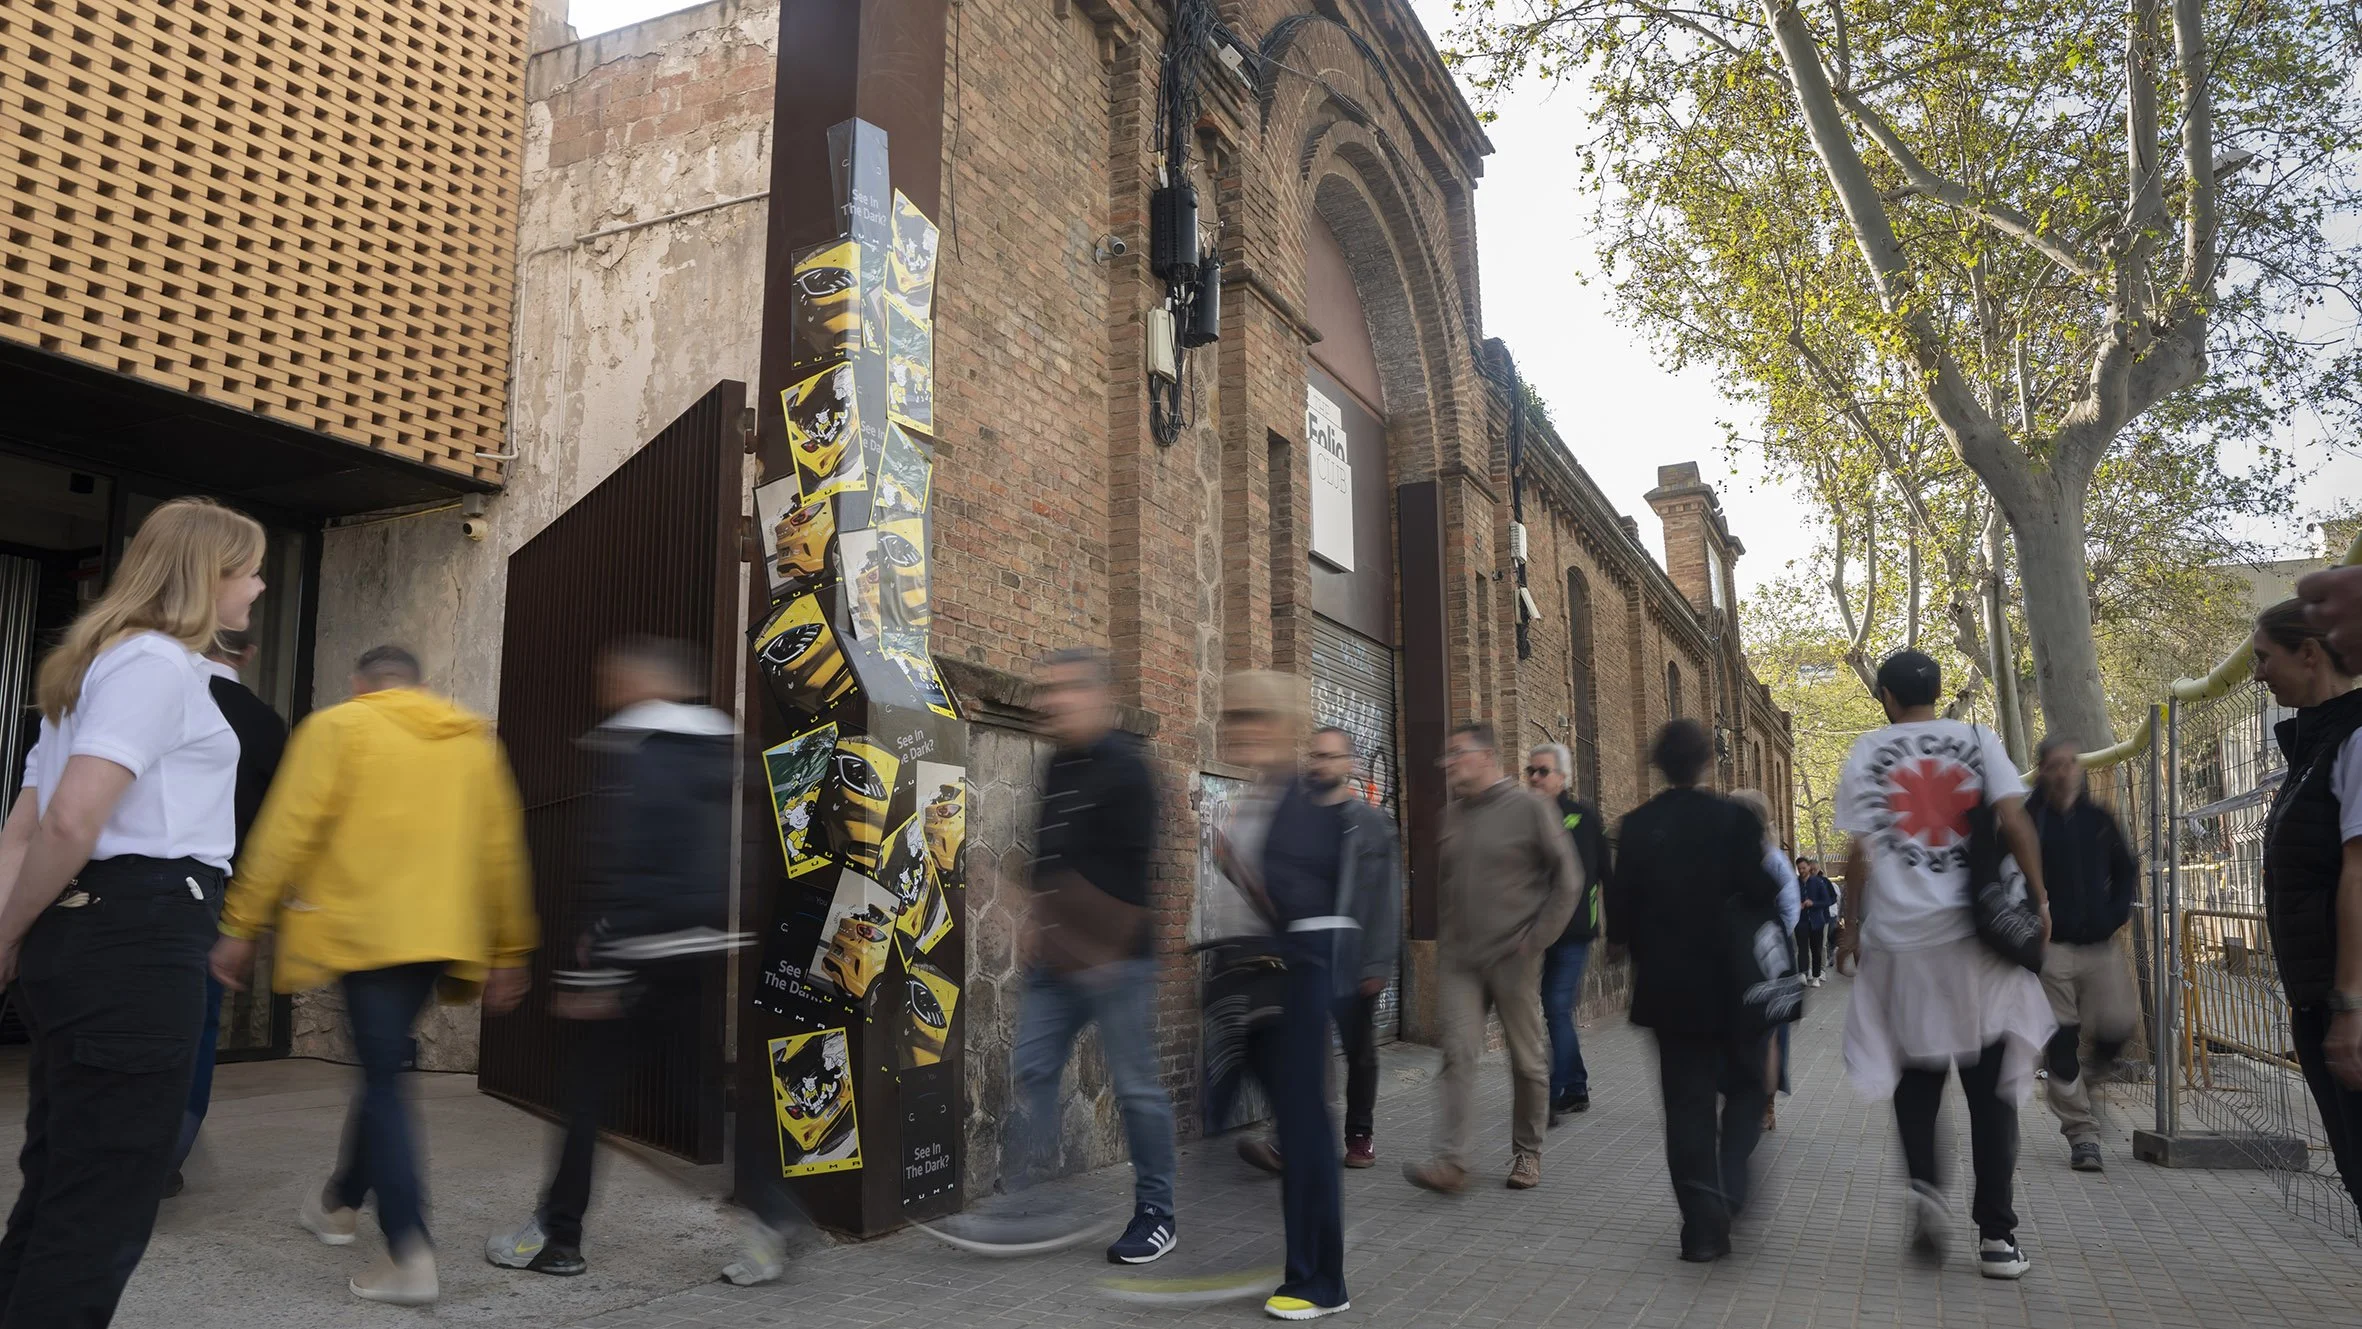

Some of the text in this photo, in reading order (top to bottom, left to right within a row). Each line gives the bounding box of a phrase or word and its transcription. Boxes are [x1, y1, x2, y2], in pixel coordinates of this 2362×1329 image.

[852, 188, 879, 209] See In
[840, 202, 887, 226] The Dark?
[793, 351, 860, 367] PUMA
[861, 420, 876, 435] See
[1308, 411, 1346, 463] Folio
[1316, 452, 1348, 495] CLUB
[772, 576, 843, 605] PUMA
[791, 686, 858, 737] PUMA
[896, 729, 924, 750] See In
[909, 739, 934, 760] Dark?
[804, 842, 874, 877] PUMA
[779, 960, 801, 978] See
[765, 971, 787, 991] The
[754, 999, 826, 1030] PUMA
[803, 984, 873, 1024] PUMA
[914, 1142, 942, 1161] See In
[785, 1160, 861, 1175] PUMA
[905, 1154, 950, 1180] The Dark?
[903, 1182, 954, 1205] PUMA
